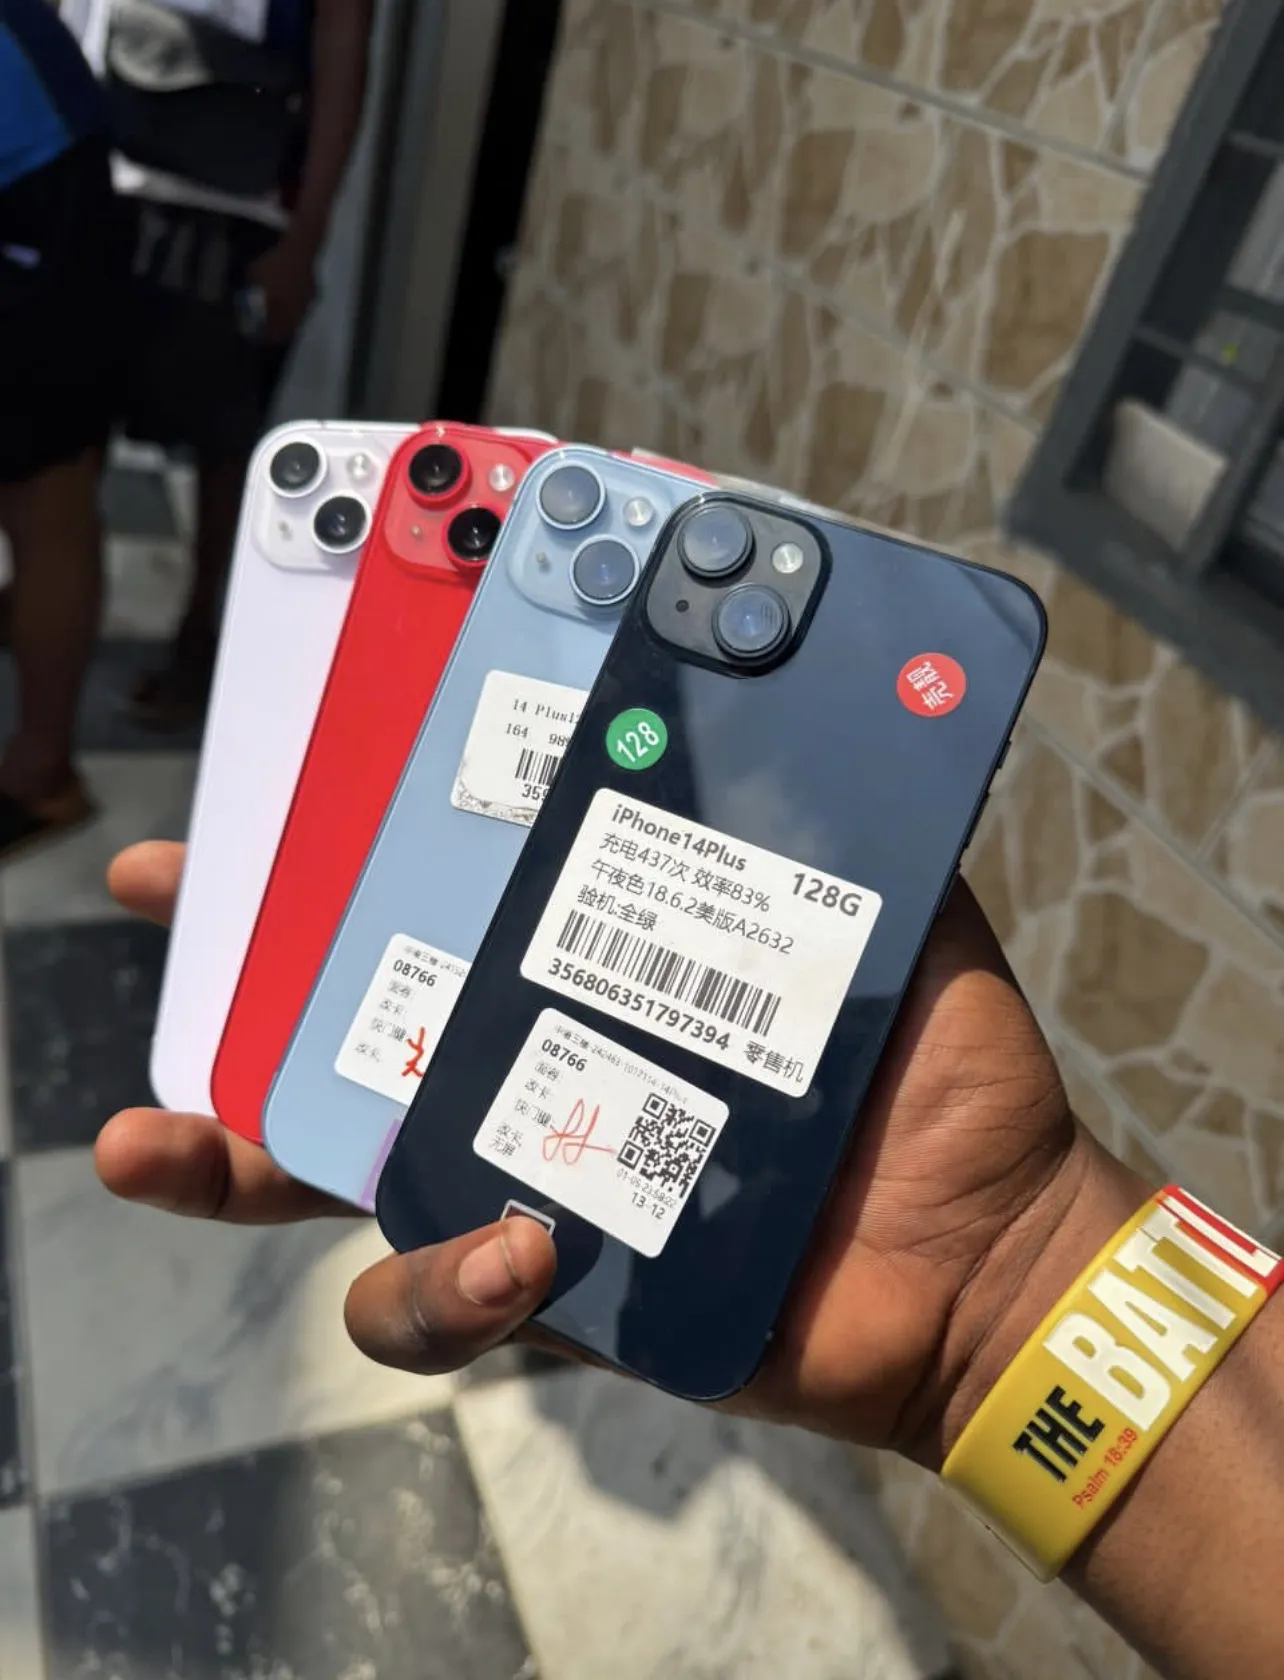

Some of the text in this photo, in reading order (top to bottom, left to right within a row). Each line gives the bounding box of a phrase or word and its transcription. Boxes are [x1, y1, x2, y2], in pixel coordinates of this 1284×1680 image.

[505, 723, 529, 738] 164
[513, 699, 527, 713] 14
[617, 721, 659, 762] 128
[599, 831, 771, 913] 充电437次 效率83%
[611, 804, 863, 917] iPhone14Plus 128G
[591, 858, 794, 955] 午夜色18.6.2美版A2632
[393, 959, 438, 987] 08766
[547, 958, 731, 1051] 356806351797394
[541, 1038, 588, 1072] 08766
[742, 1041, 804, 1083] 零售机
[1012, 1187, 1282, 1483] THE BATTL
[1072, 1427, 1138, 1510] Psalm 18:39
